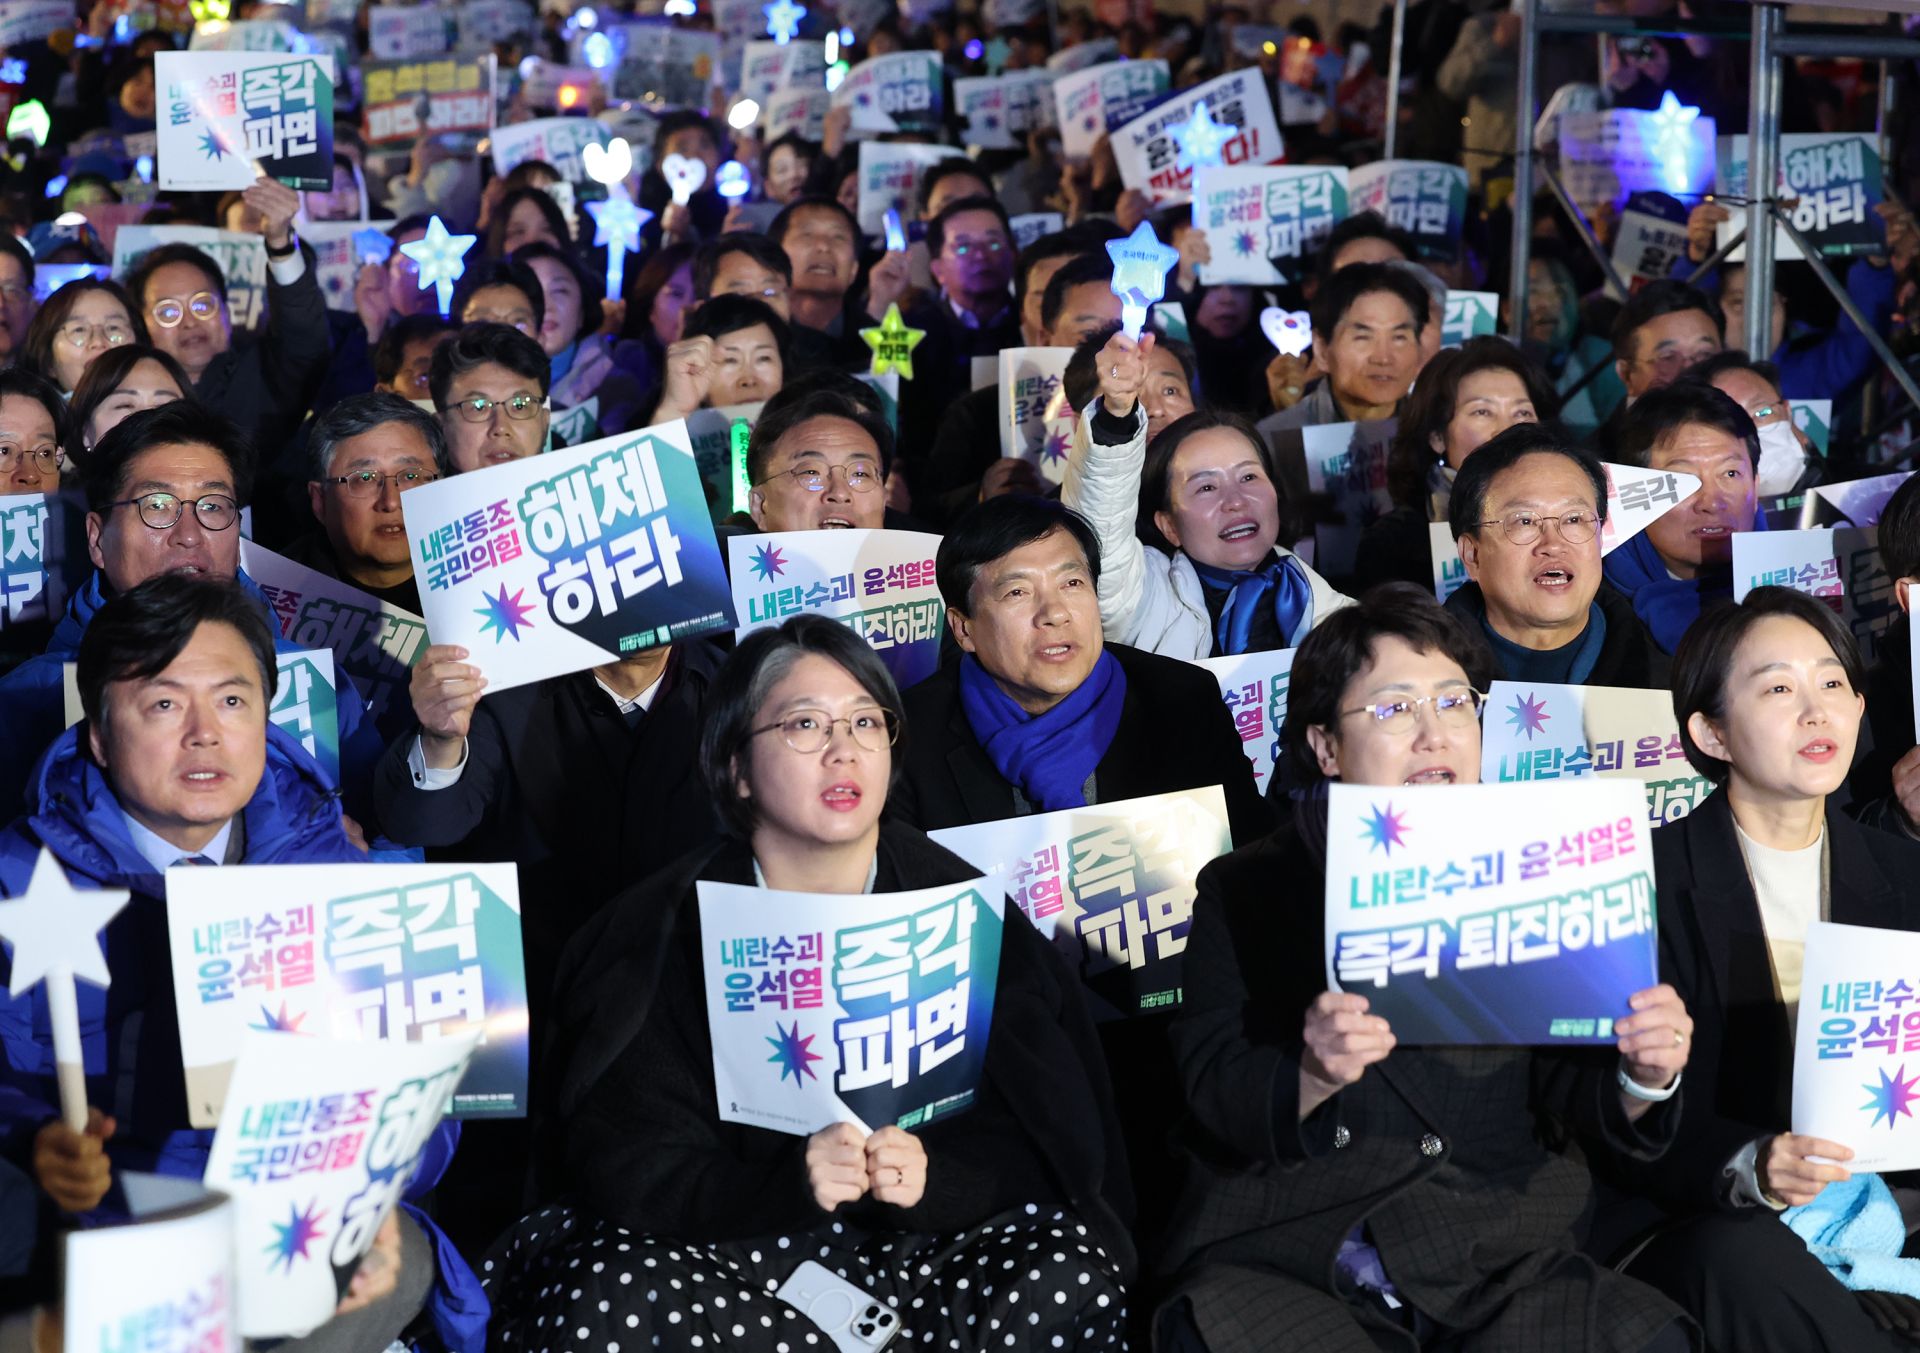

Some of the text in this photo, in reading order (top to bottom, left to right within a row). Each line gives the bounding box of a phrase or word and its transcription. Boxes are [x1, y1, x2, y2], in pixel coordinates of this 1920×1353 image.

[169, 92, 237, 126] 윤열
[246, 61, 317, 112] 즉각
[246, 108, 317, 160] 파면
[1389, 171, 1450, 203] 즉각
[1789, 140, 1864, 189] 해체
[1269, 174, 1333, 213] 즉각
[1388, 203, 1450, 235] 파면
[1792, 182, 1867, 232] 하라
[1443, 299, 1479, 340] 각
[879, 345, 909, 361] 파면
[523, 438, 668, 554] 해체
[1618, 474, 1679, 511] 즉각
[420, 498, 515, 563] 내란동조
[427, 529, 523, 592] 국민의힘
[542, 514, 684, 625] 하라
[1751, 558, 1842, 592] 내란수괴
[749, 559, 937, 623] 내란수괴 윤석열은
[296, 597, 426, 678] 해체
[850, 601, 939, 651] 진하라!
[268, 662, 315, 733] 각
[1222, 679, 1264, 713] 수괴
[1499, 740, 1625, 784] 내란수괴
[1007, 845, 1061, 884] 수괴
[1351, 816, 1637, 910] 내란수괴 윤석열은
[193, 905, 315, 956] 내란수괴
[331, 878, 481, 976] 즉각
[720, 932, 824, 968] 내란수괴
[836, 895, 978, 1004] 즉각
[1080, 885, 1193, 971] 파면
[1337, 872, 1653, 988] 즉각 퇴진하라!
[198, 940, 316, 1004] 윤석열
[724, 967, 824, 1012] 윤석열
[838, 976, 971, 1092] 파면
[239, 1088, 379, 1140] 내란동조
[230, 1130, 366, 1184] 국민의힘
